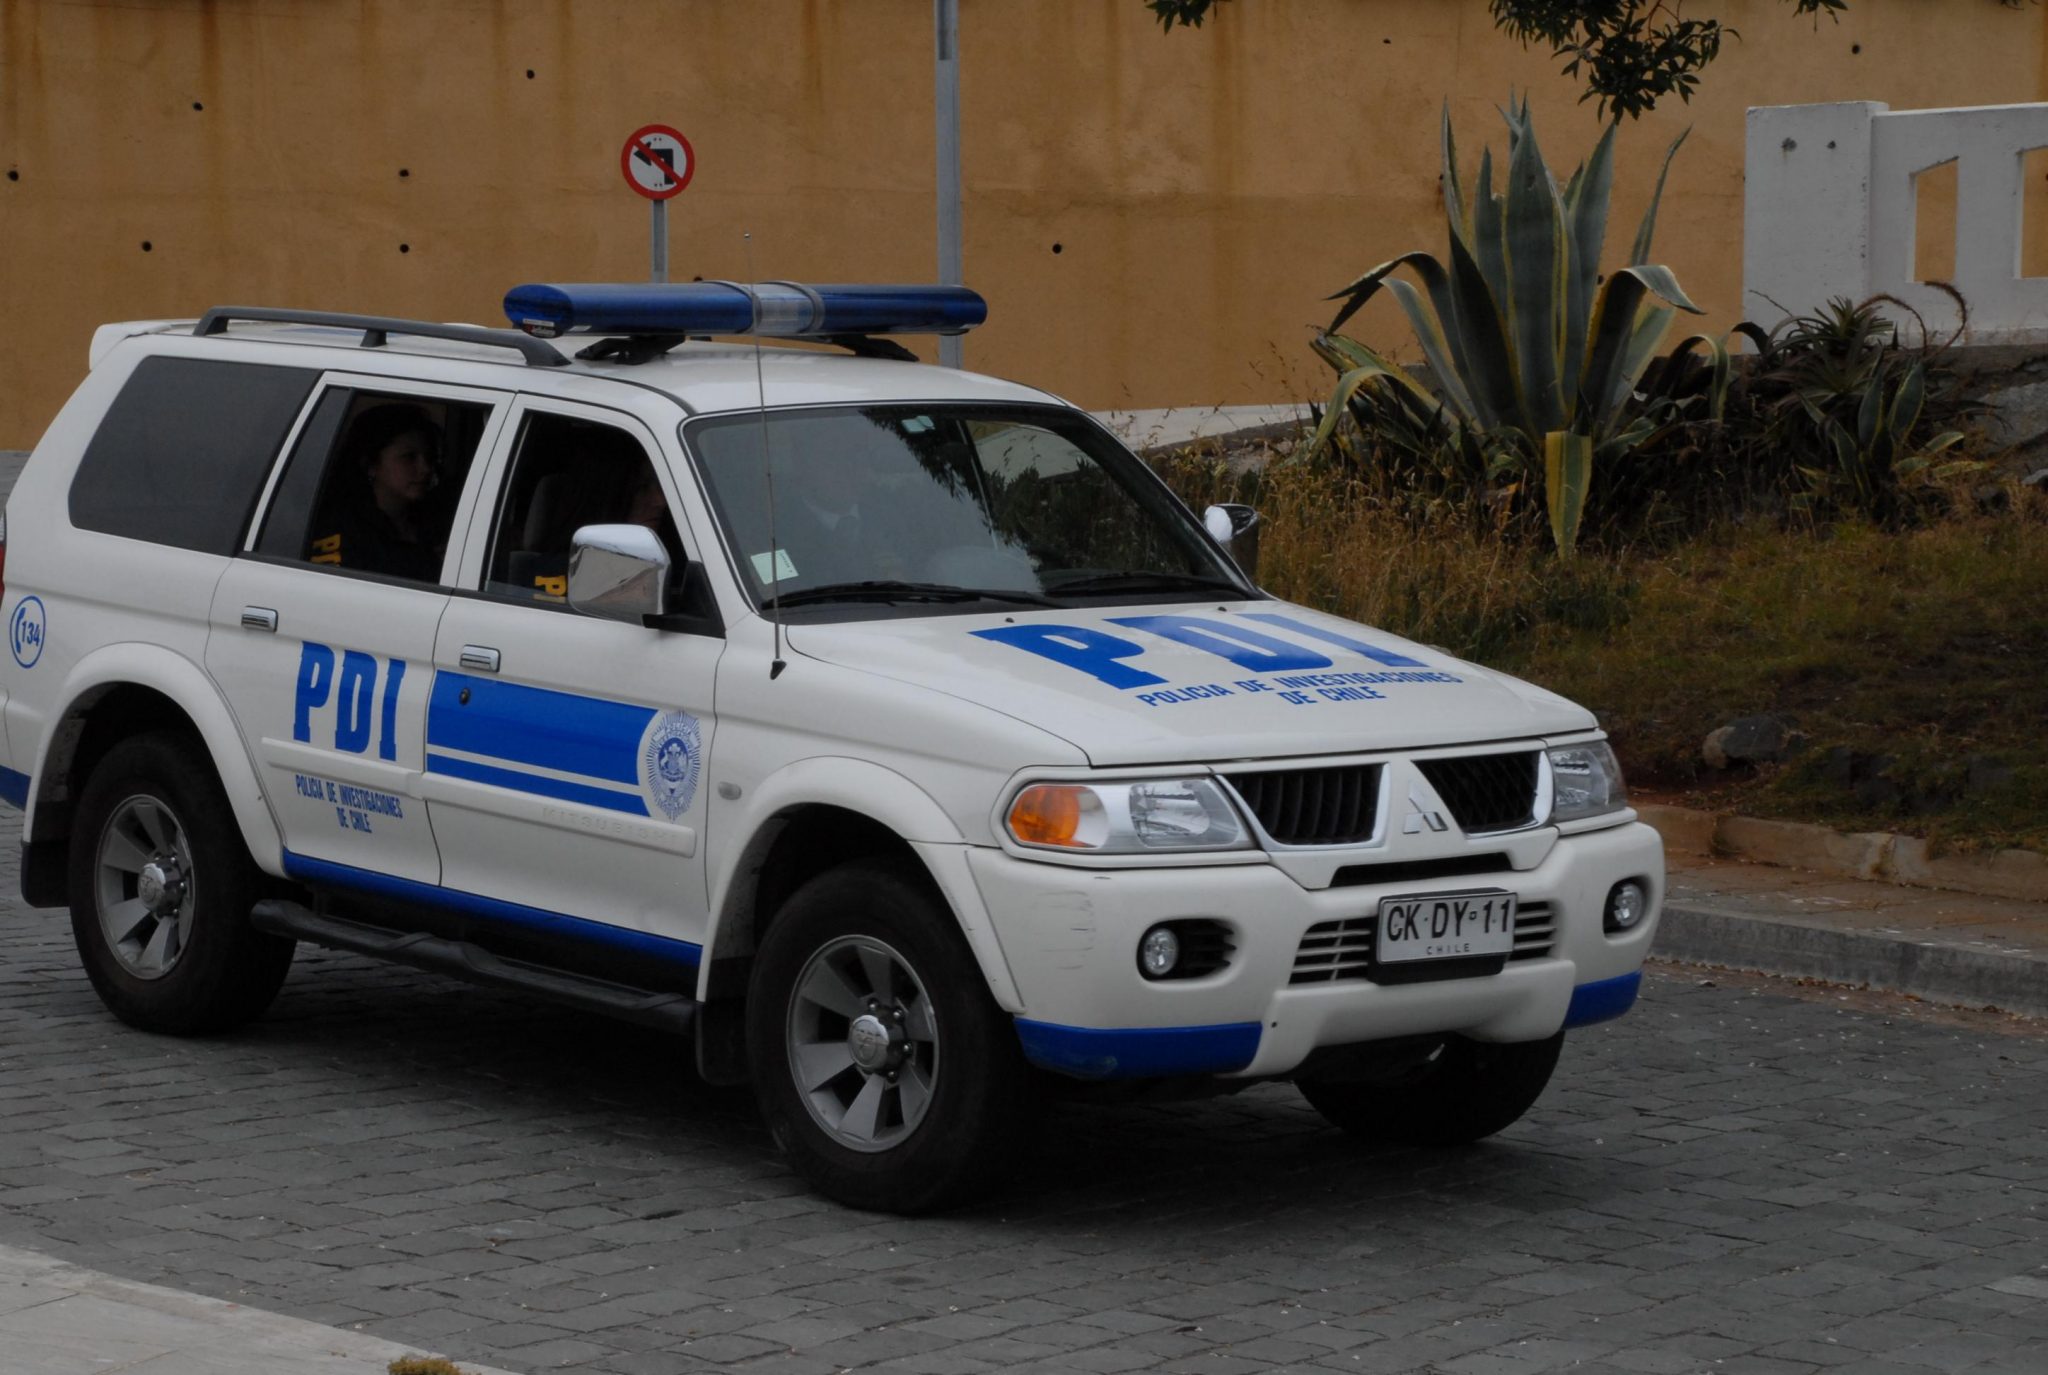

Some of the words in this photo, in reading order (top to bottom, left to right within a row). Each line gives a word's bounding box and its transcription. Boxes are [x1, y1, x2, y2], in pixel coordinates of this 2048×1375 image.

[22, 620, 40, 647] 134
[966, 613, 1430, 690] PDI
[293, 641, 406, 762] PDI
[1135, 683, 1235, 706] POLICIA
[1234, 679, 1275, 693] DE
[1273, 671, 1464, 688] INVESTIGACIONES
[1277, 690, 1317, 706] DE
[1317, 685, 1387, 702] CHILE
[295, 774, 325, 800] POLICIA
[326, 781, 338, 803] DE
[339, 784, 403, 818] INVESTIGACIONES
[336, 807, 349, 828] DE
[349, 809, 372, 833] CHILE
[1426, 943, 1470, 955] CHILE
